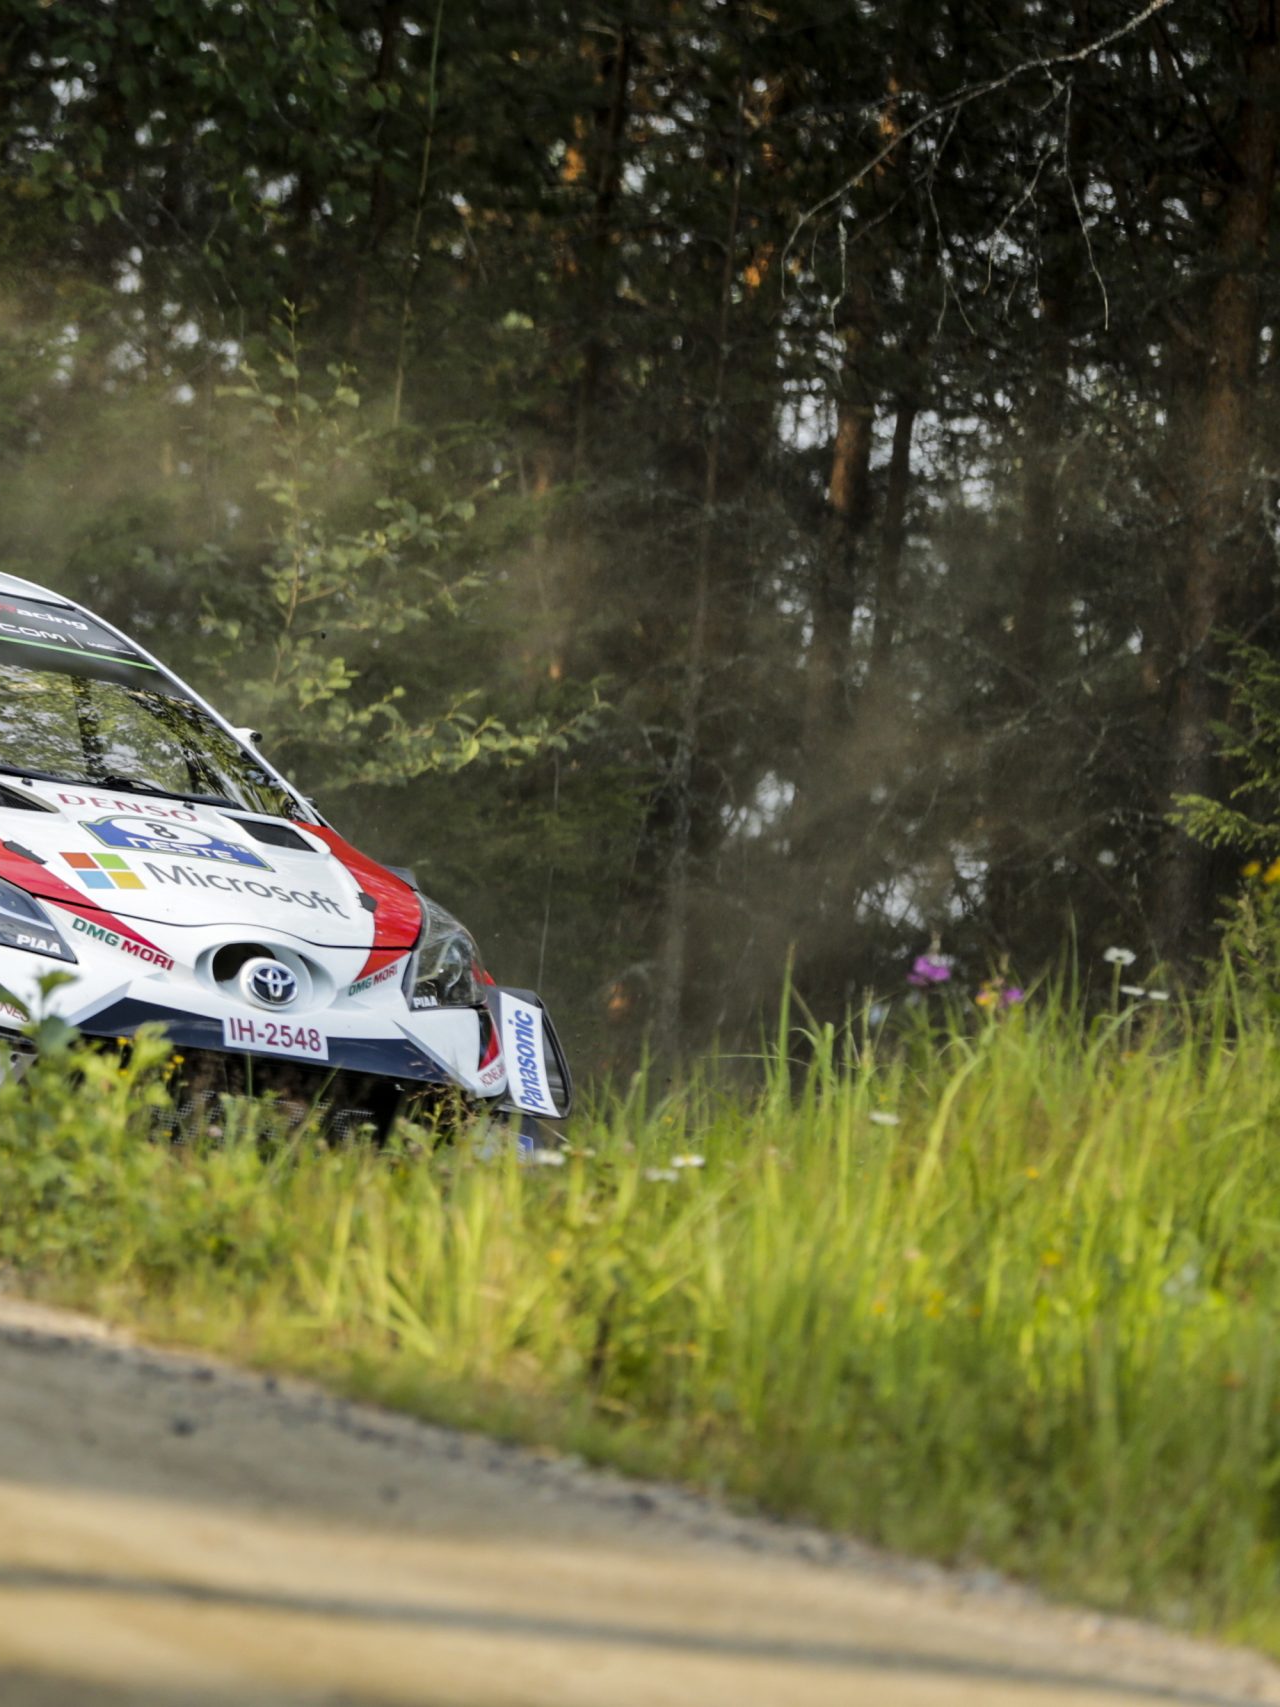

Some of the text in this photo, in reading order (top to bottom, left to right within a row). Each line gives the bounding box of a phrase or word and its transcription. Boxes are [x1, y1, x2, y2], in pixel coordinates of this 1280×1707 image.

[58, 793, 198, 822] DENSO
[144, 822, 180, 841] 8
[128, 837, 240, 863] NESTE
[143, 862, 351, 920] Microsoft
[16, 933, 62, 955] PIAA
[71, 917, 175, 971] DMG MORI
[373, 964, 398, 986] MORI
[229, 1016, 322, 1053] IH-2548
[507, 1009, 548, 1111] Panasonic
